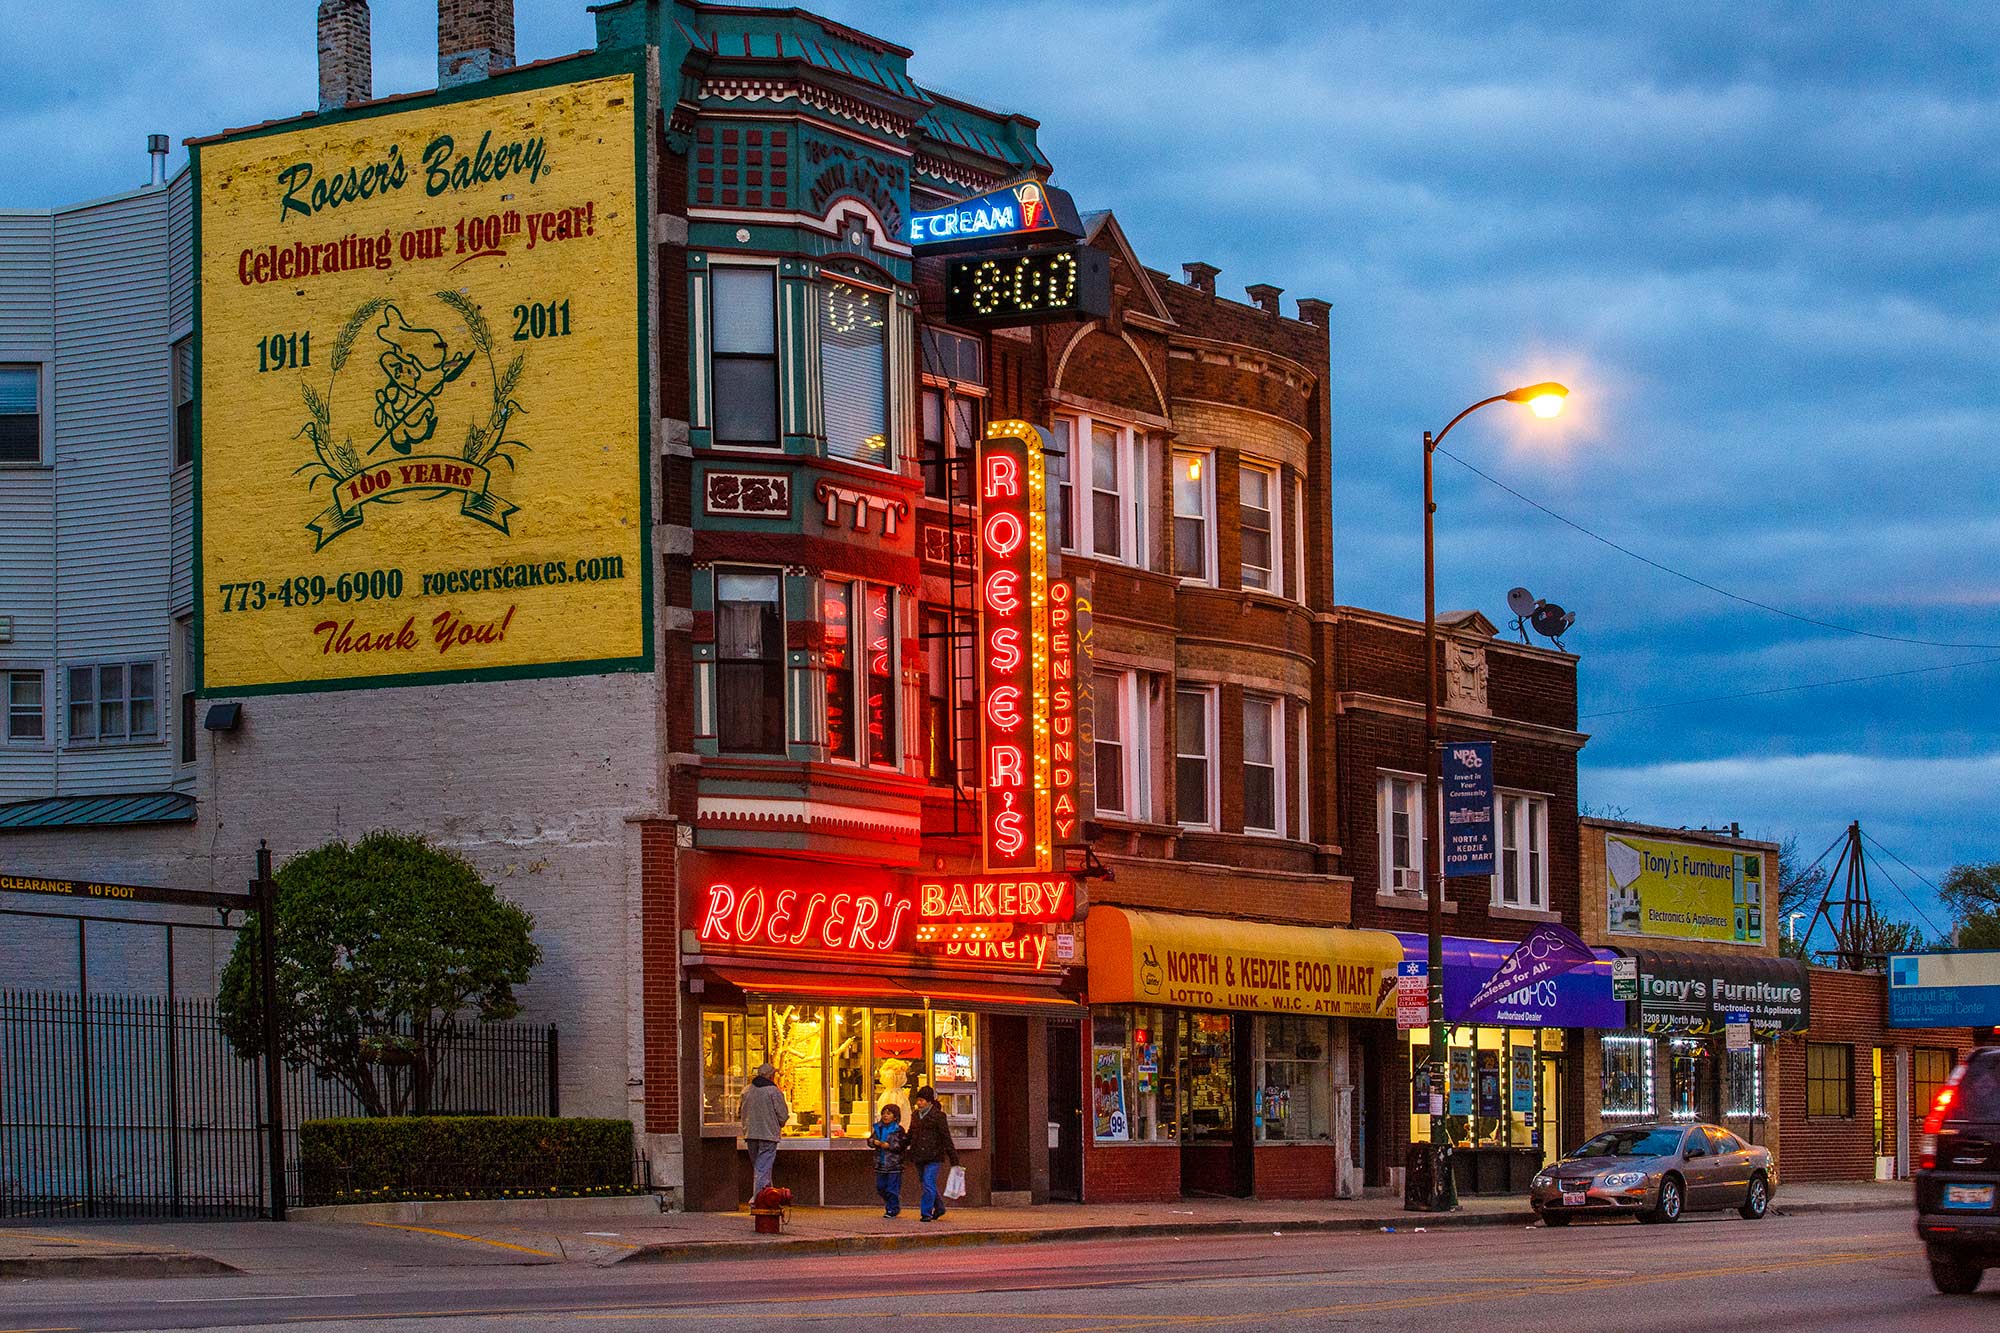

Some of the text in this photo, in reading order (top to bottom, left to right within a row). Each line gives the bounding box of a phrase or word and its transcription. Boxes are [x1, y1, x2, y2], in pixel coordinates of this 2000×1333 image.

[277, 144, 408, 222] Roeser's
[930, 207, 1014, 235] CREAM
[238, 202, 595, 286] Celebrating our 100th year!
[513, 298, 572, 342] 2011
[256, 330, 311, 373] 1911
[346, 462, 474, 501] 100 YEARS
[219, 554, 625, 613] 773-489-6900 roeserscakes.com
[313, 605, 517, 655] Thank You!
[984, 455, 1023, 856] ROESER'S
[1051, 583, 1074, 838] OPEN SUNDAY
[1450, 790, 1487, 798] Community
[1452, 834, 1488, 843] NORTH &
[1456, 844, 1484, 852] KEDZIE
[1447, 852, 1493, 862] FOOD MART
[1643, 851, 1731, 880] Tony's Furniture
[0, 877, 136, 899] CLEARANCE 10 FOOT
[920, 882, 1065, 917] BAKERY
[701, 884, 911, 950] ROESER'S
[1649, 908, 1728, 929] Electronics & Appliances
[1167, 950, 1375, 997] NORTH & KEDZIE FOOD MART
[1512, 971, 1530, 984] for
[1533, 962, 1551, 976] All.
[1170, 988, 1213, 1004] LOTTO
[1228, 993, 1259, 1008] LINK
[1272, 996, 1302, 1011] W.I.C
[1314, 999, 1341, 1013] ATM
[1640, 973, 1707, 1001] Tony's
[1712, 978, 1802, 1003] Furniture
[1893, 989, 1960, 1001] Humboldt Park
[1497, 1010, 1542, 1022] Authorized Dealer
[1643, 1013, 1660, 1024] 3208
[1661, 1014, 1669, 1024] W
[1670, 1015, 1689, 1025] North
[1713, 1002, 1802, 1017] Electronics & Appliances
[1894, 1001, 1985, 1017] Family Health Center
